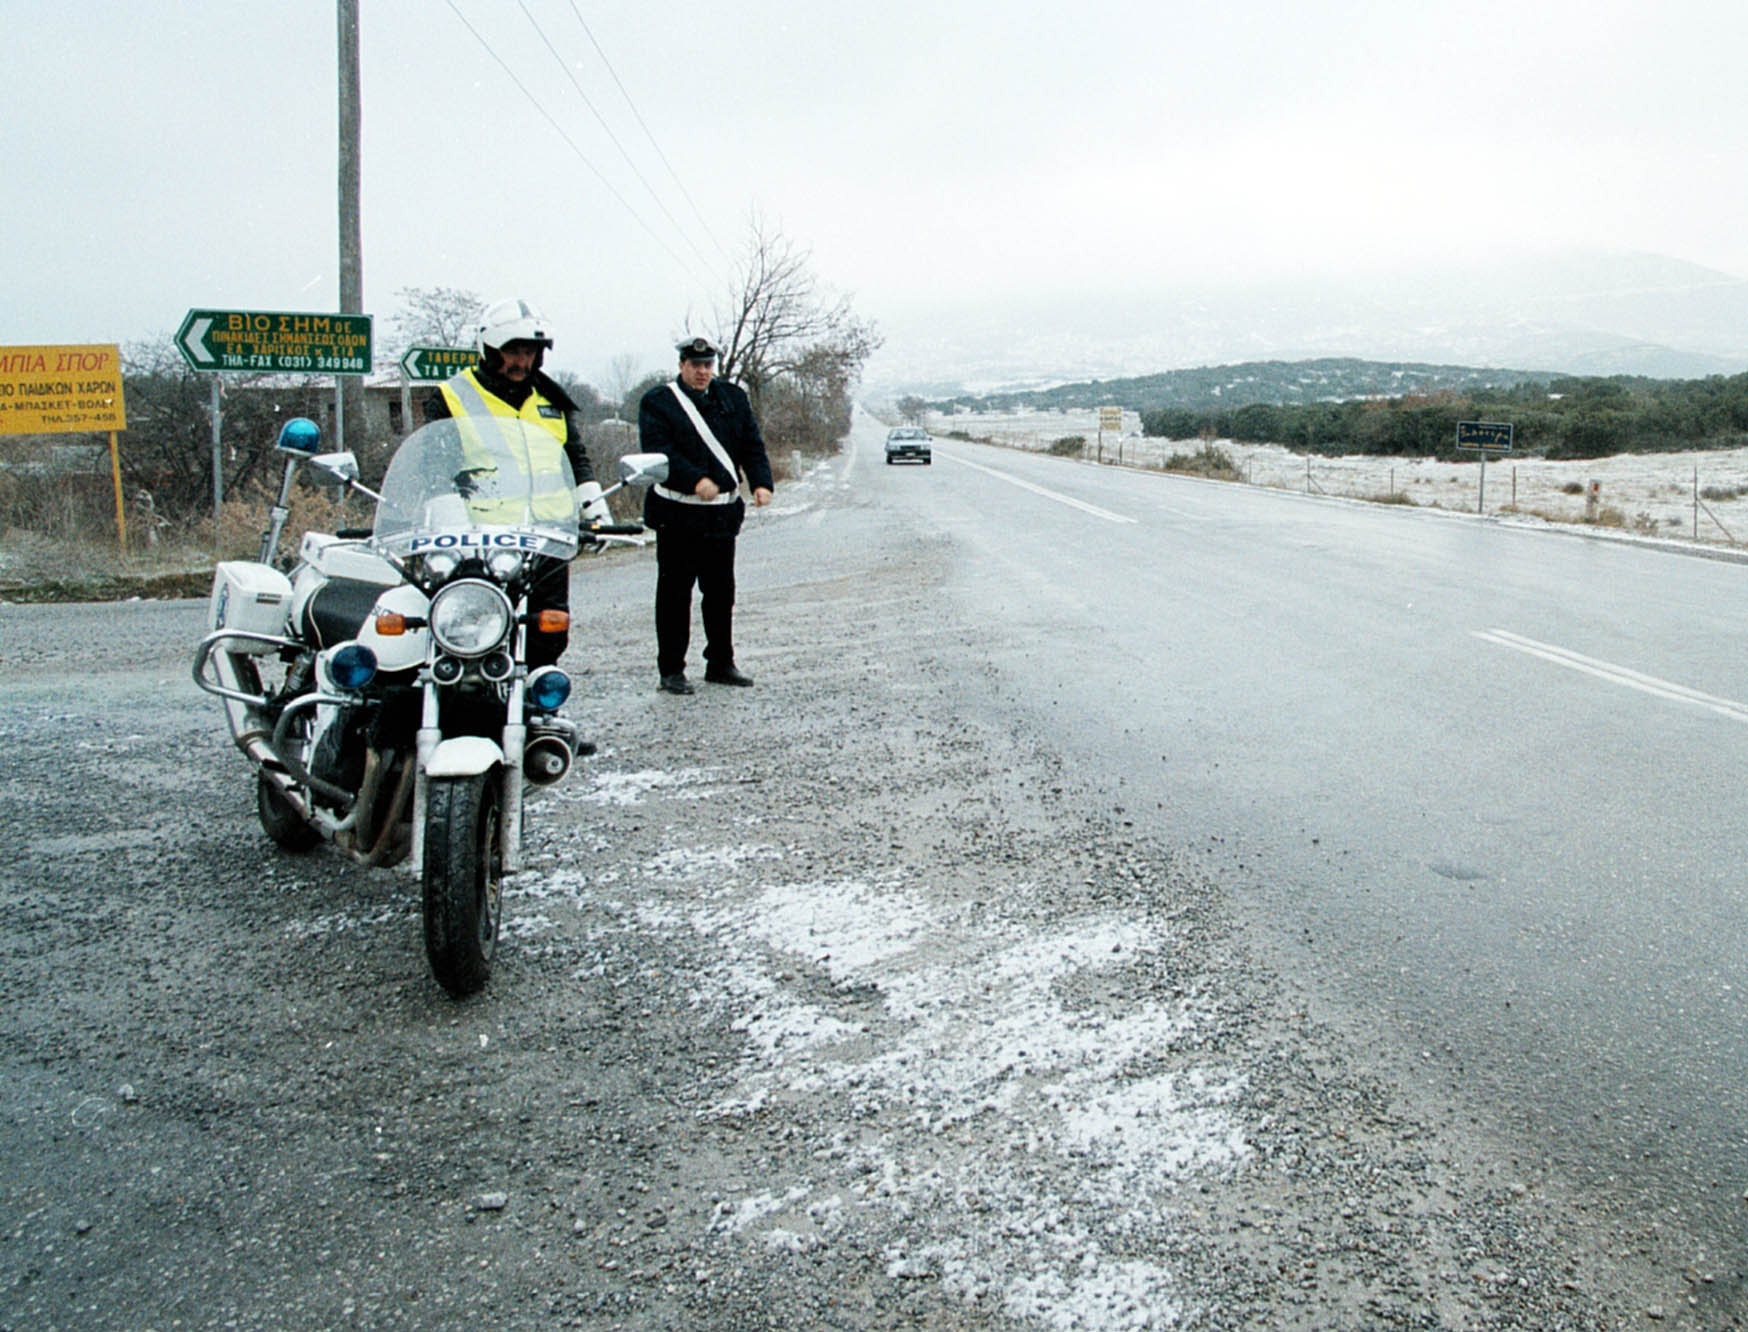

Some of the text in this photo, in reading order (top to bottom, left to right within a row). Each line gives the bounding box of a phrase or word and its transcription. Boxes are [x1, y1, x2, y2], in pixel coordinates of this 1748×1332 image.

[228, 314, 271, 331] ΒΙΟ
[278, 316, 330, 333] ΣΗΜ
[56, 352, 110, 372] ΣΠΟΡ
[278, 355, 312, 369] (031)
[424, 364, 440, 377] ΤΑ
[411, 533, 538, 551] POLICE
